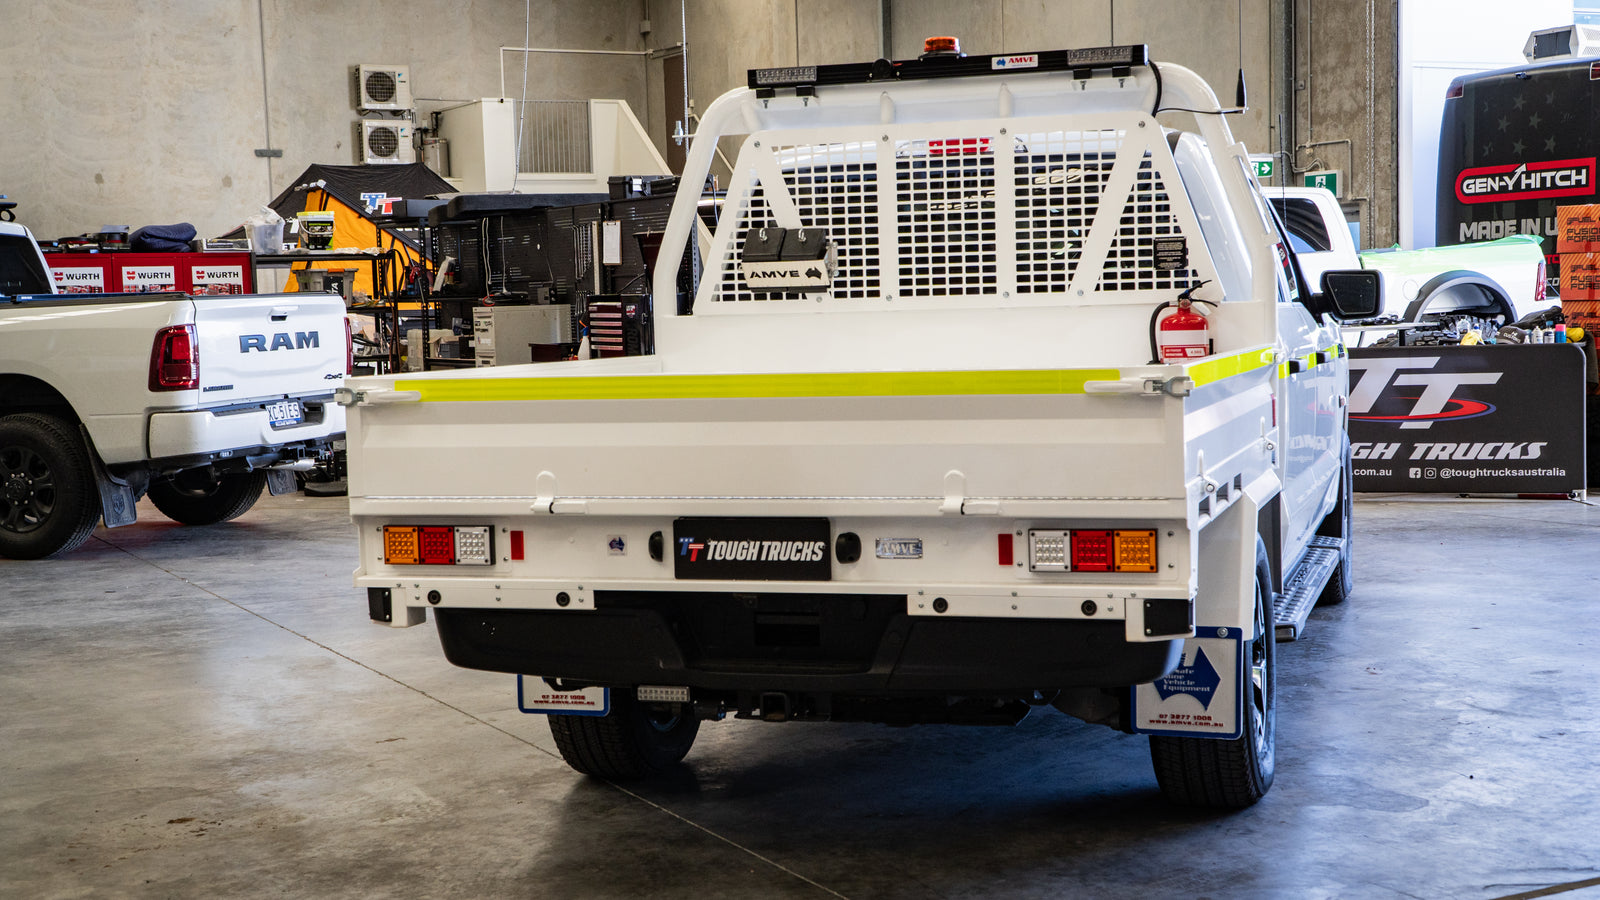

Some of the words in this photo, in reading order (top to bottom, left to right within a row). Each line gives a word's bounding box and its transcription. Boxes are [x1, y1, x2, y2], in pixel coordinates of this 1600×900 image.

[1008, 56, 1036, 64] AMVE
[1521, 168, 1587, 190] HITCH
[1460, 219, 1517, 242] MADE
[1521, 218, 1541, 235] IN
[1566, 227, 1600, 236] FUSIO
[65, 273, 100, 281] WÜRTH
[138, 272, 171, 280] WÜRTH
[207, 271, 239, 279] WÜRTH
[749, 270, 800, 279] AMVE
[239, 331, 320, 353] RAM
[1409, 442, 1548, 460] TRUCKS
[1440, 466, 1567, 480] @toughtrucksaustralia
[706, 540, 760, 561] TOUGH
[761, 540, 826, 562] TRUCKS
